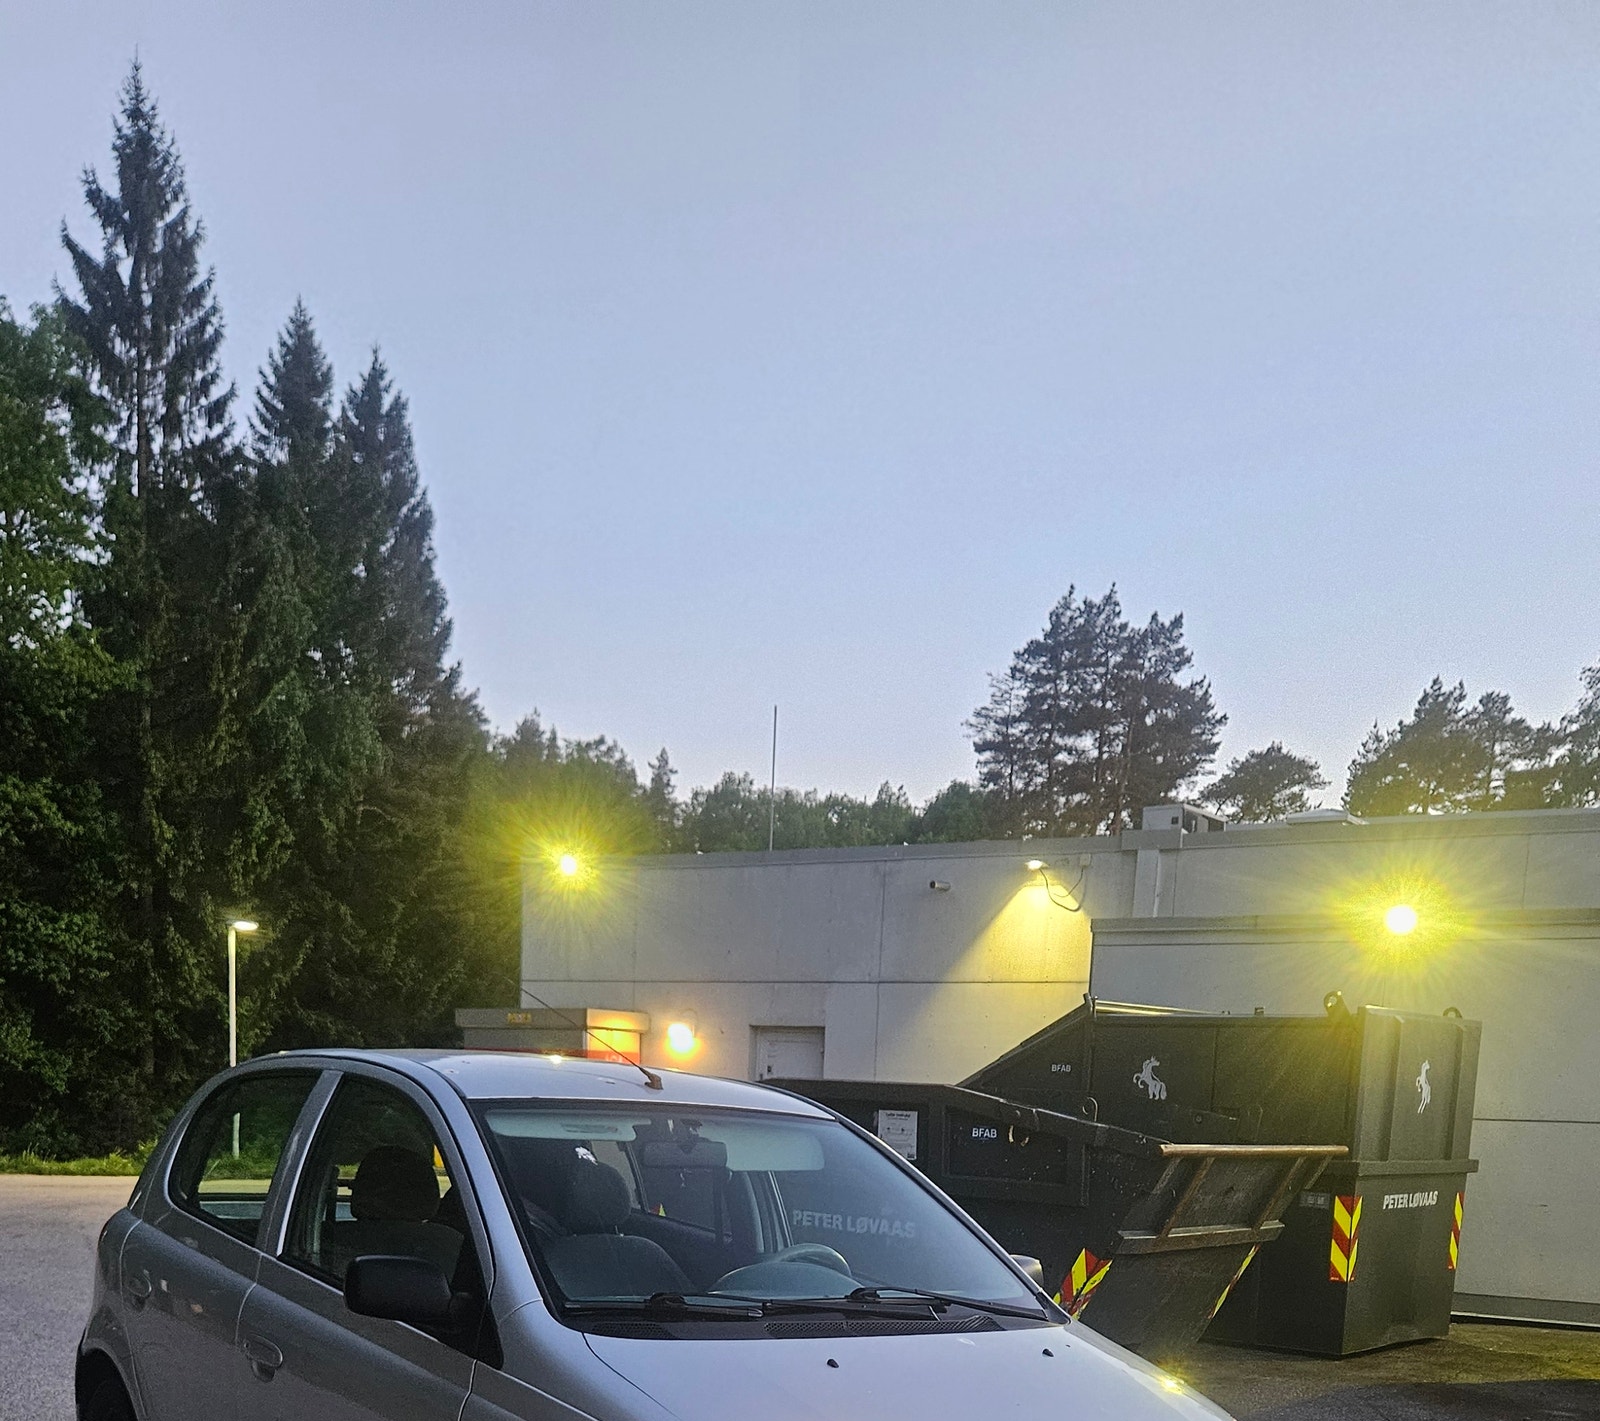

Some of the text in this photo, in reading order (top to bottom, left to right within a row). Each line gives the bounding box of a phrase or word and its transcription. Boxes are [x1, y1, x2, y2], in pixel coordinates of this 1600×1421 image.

[1051, 1064, 1072, 1073] BFAB
[972, 1127, 997, 1138] BFAB
[1383, 1190, 1439, 1210] PETER LØVAAS
[793, 1209, 917, 1239] PETER LØVAAS
